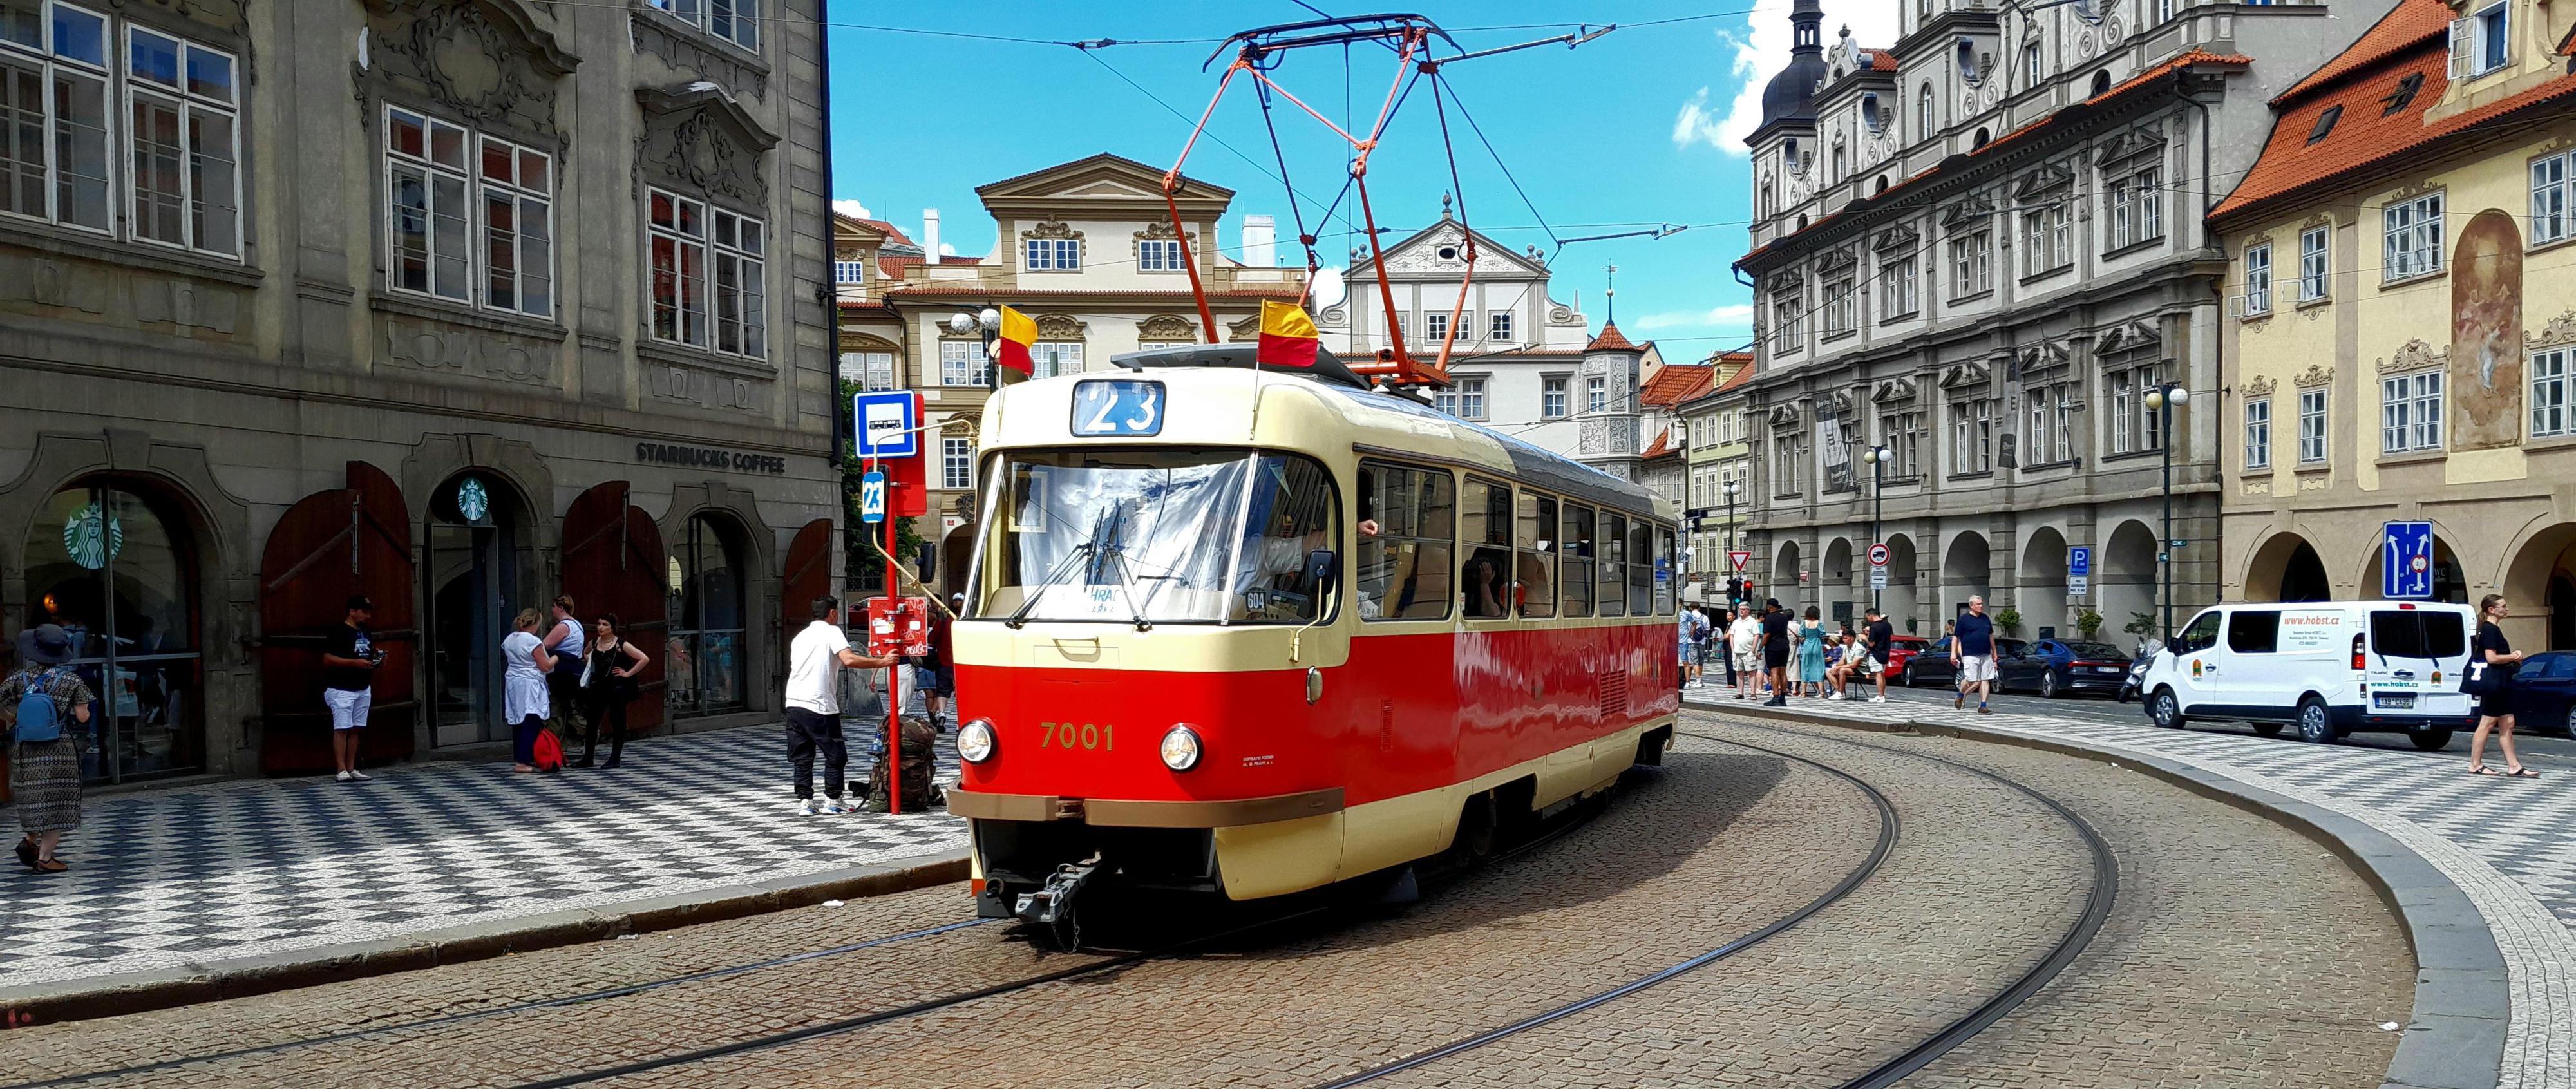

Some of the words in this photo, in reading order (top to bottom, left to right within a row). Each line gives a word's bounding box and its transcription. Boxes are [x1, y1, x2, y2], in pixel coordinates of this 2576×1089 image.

[1084, 383, 1157, 431] 23
[637, 442, 730, 468] STARBUCKS
[733, 453, 786, 473] COFFEE
[863, 481, 885, 515] 23
[2074, 551, 2085, 566] P
[1247, 592, 1264, 609] 604
[2284, 615, 2340, 625] www.hobst.cz
[1040, 721, 1113, 751] 7001
